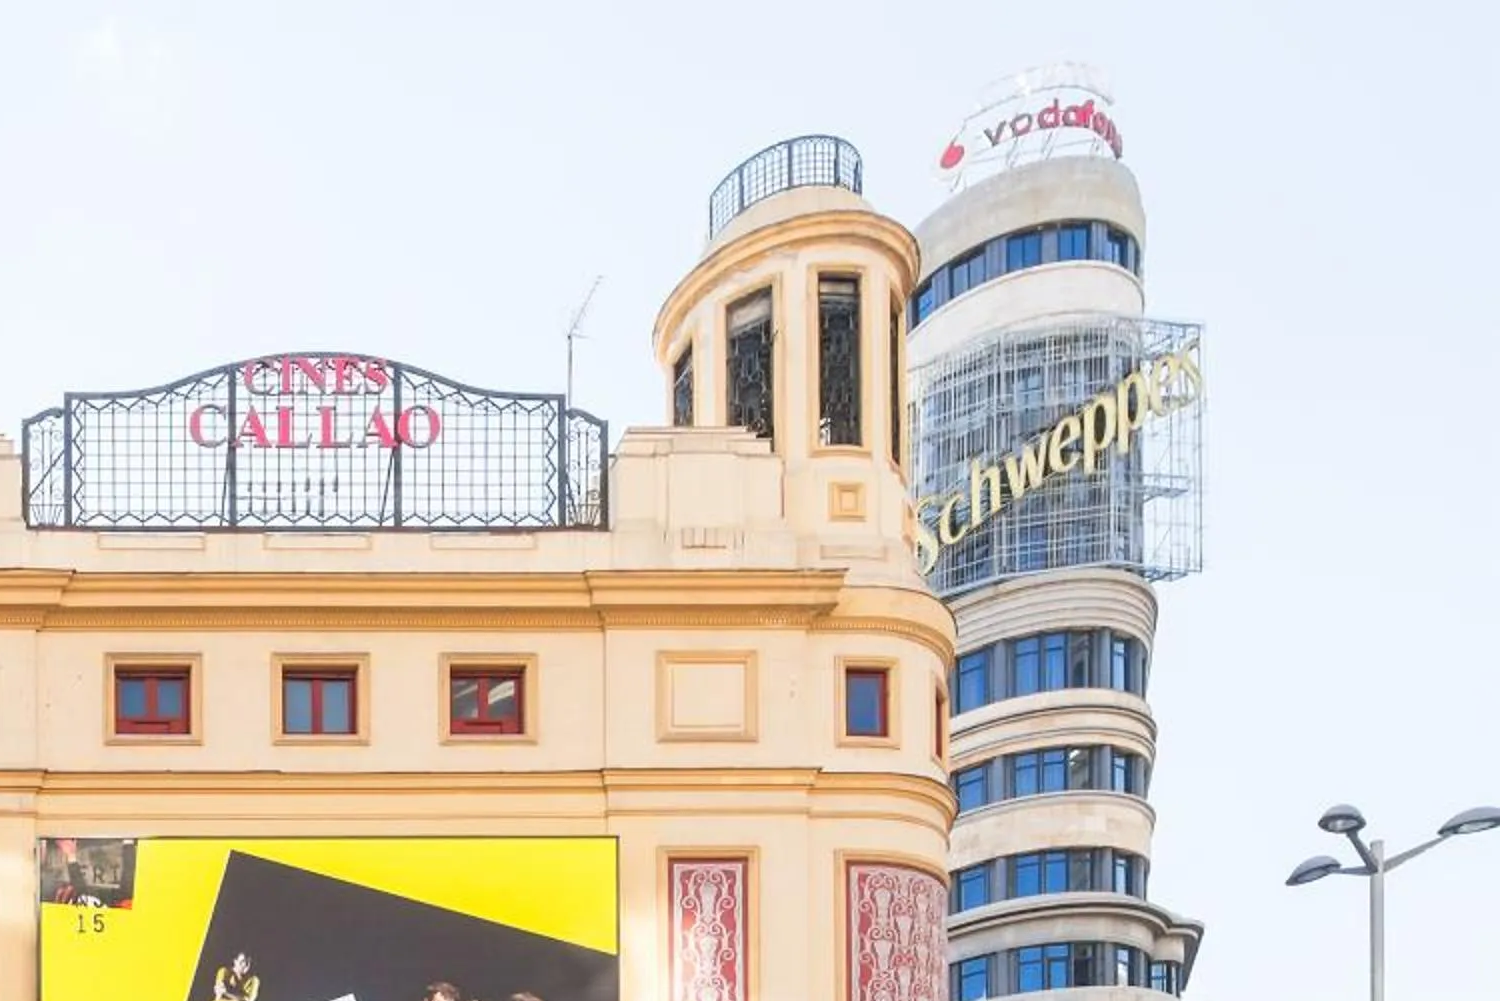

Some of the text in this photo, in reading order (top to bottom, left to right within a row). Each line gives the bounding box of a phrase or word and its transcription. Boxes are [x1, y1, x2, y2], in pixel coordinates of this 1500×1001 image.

[244, 354, 388, 396] CINES
[189, 404, 441, 449] CALLAO
[915, 338, 1202, 577] Schweppes
